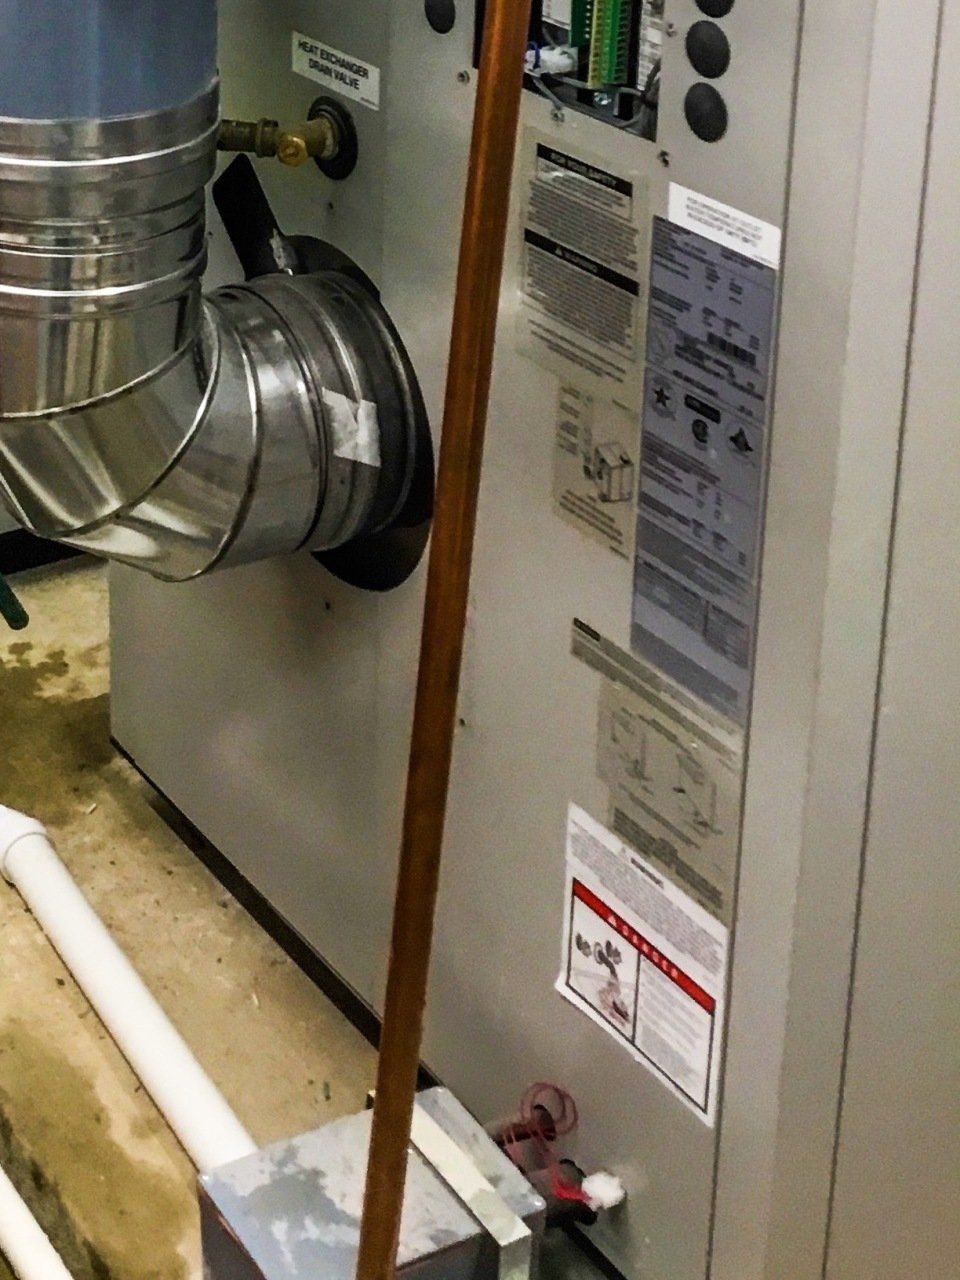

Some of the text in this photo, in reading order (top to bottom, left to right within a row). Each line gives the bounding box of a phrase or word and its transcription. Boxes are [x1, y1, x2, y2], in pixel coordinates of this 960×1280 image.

[298, 40, 369, 80] HEAT EXCHANGER
[308, 58, 360, 90] DRAIN VALVE
